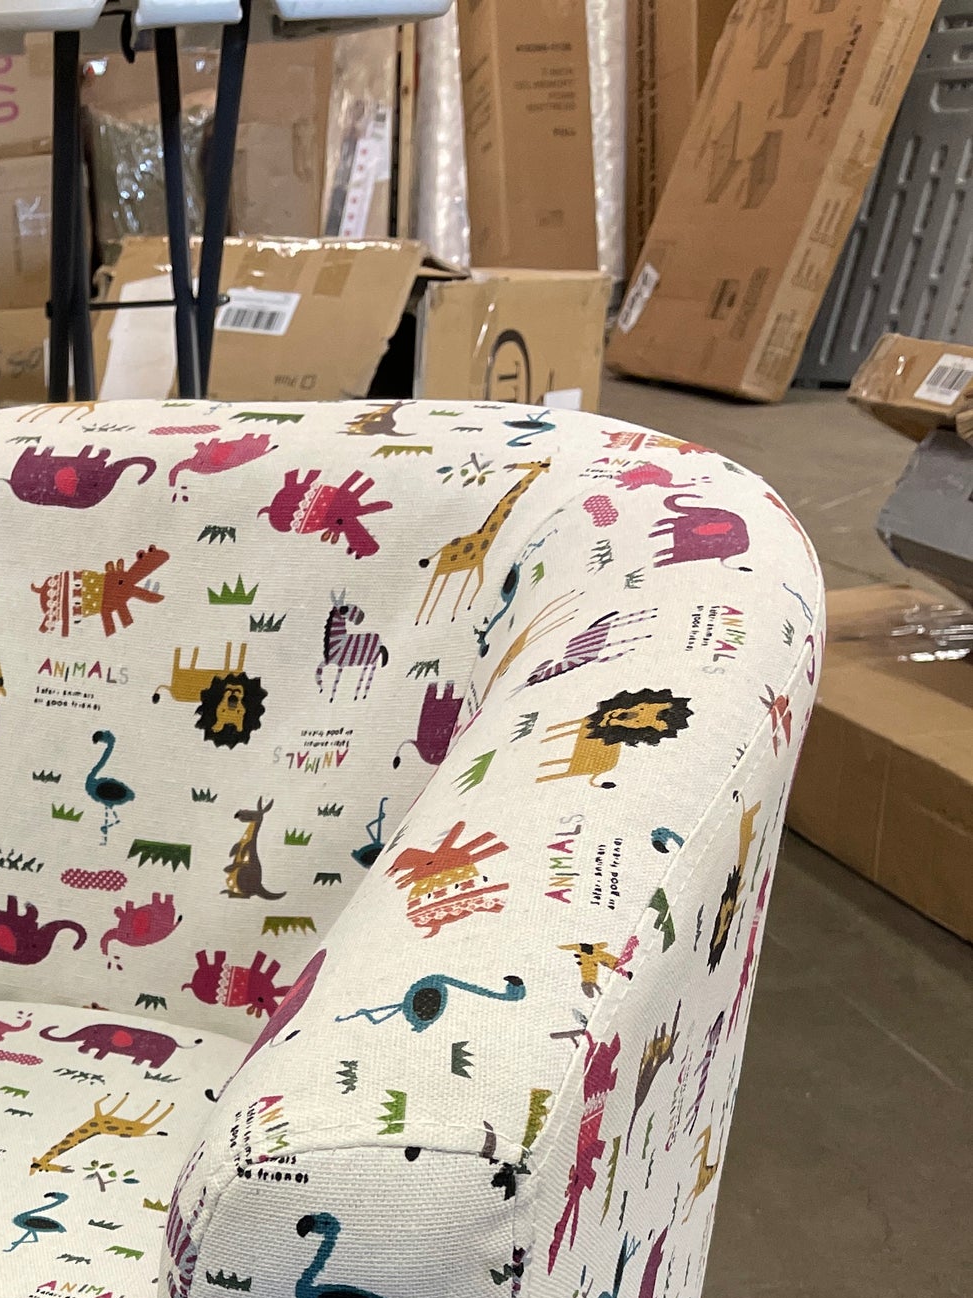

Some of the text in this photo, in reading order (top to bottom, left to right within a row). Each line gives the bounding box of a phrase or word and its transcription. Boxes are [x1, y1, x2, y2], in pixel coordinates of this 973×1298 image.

[702, 605, 747, 675] ANIMALS
[37, 657, 129, 685] ANIMALS
[273, 746, 349, 774] ANIMALS
[544, 814, 584, 904] ANIMALS
